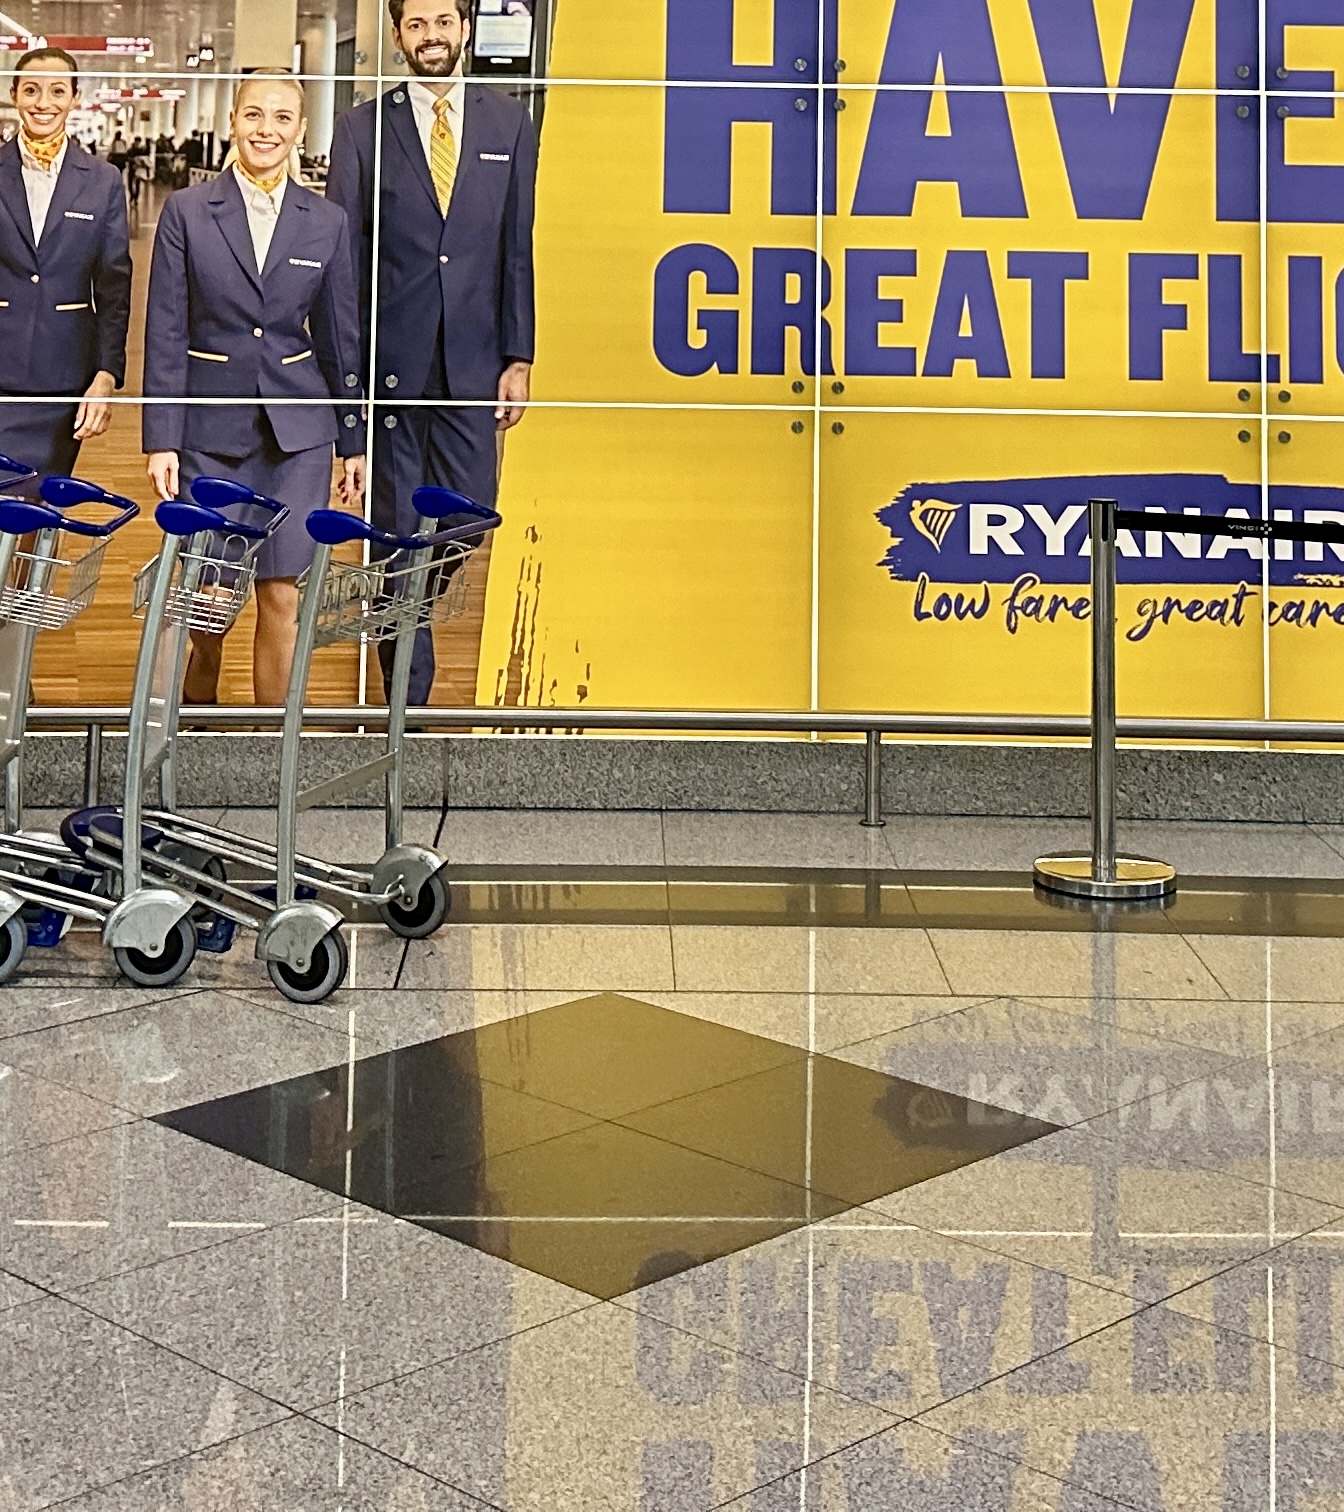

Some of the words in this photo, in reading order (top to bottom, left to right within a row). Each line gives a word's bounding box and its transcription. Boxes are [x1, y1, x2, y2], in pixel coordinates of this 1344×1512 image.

[652, 243, 1090, 379] GREAT
[914, 575, 990, 622] Low
[1125, 583, 1259, 642] great
